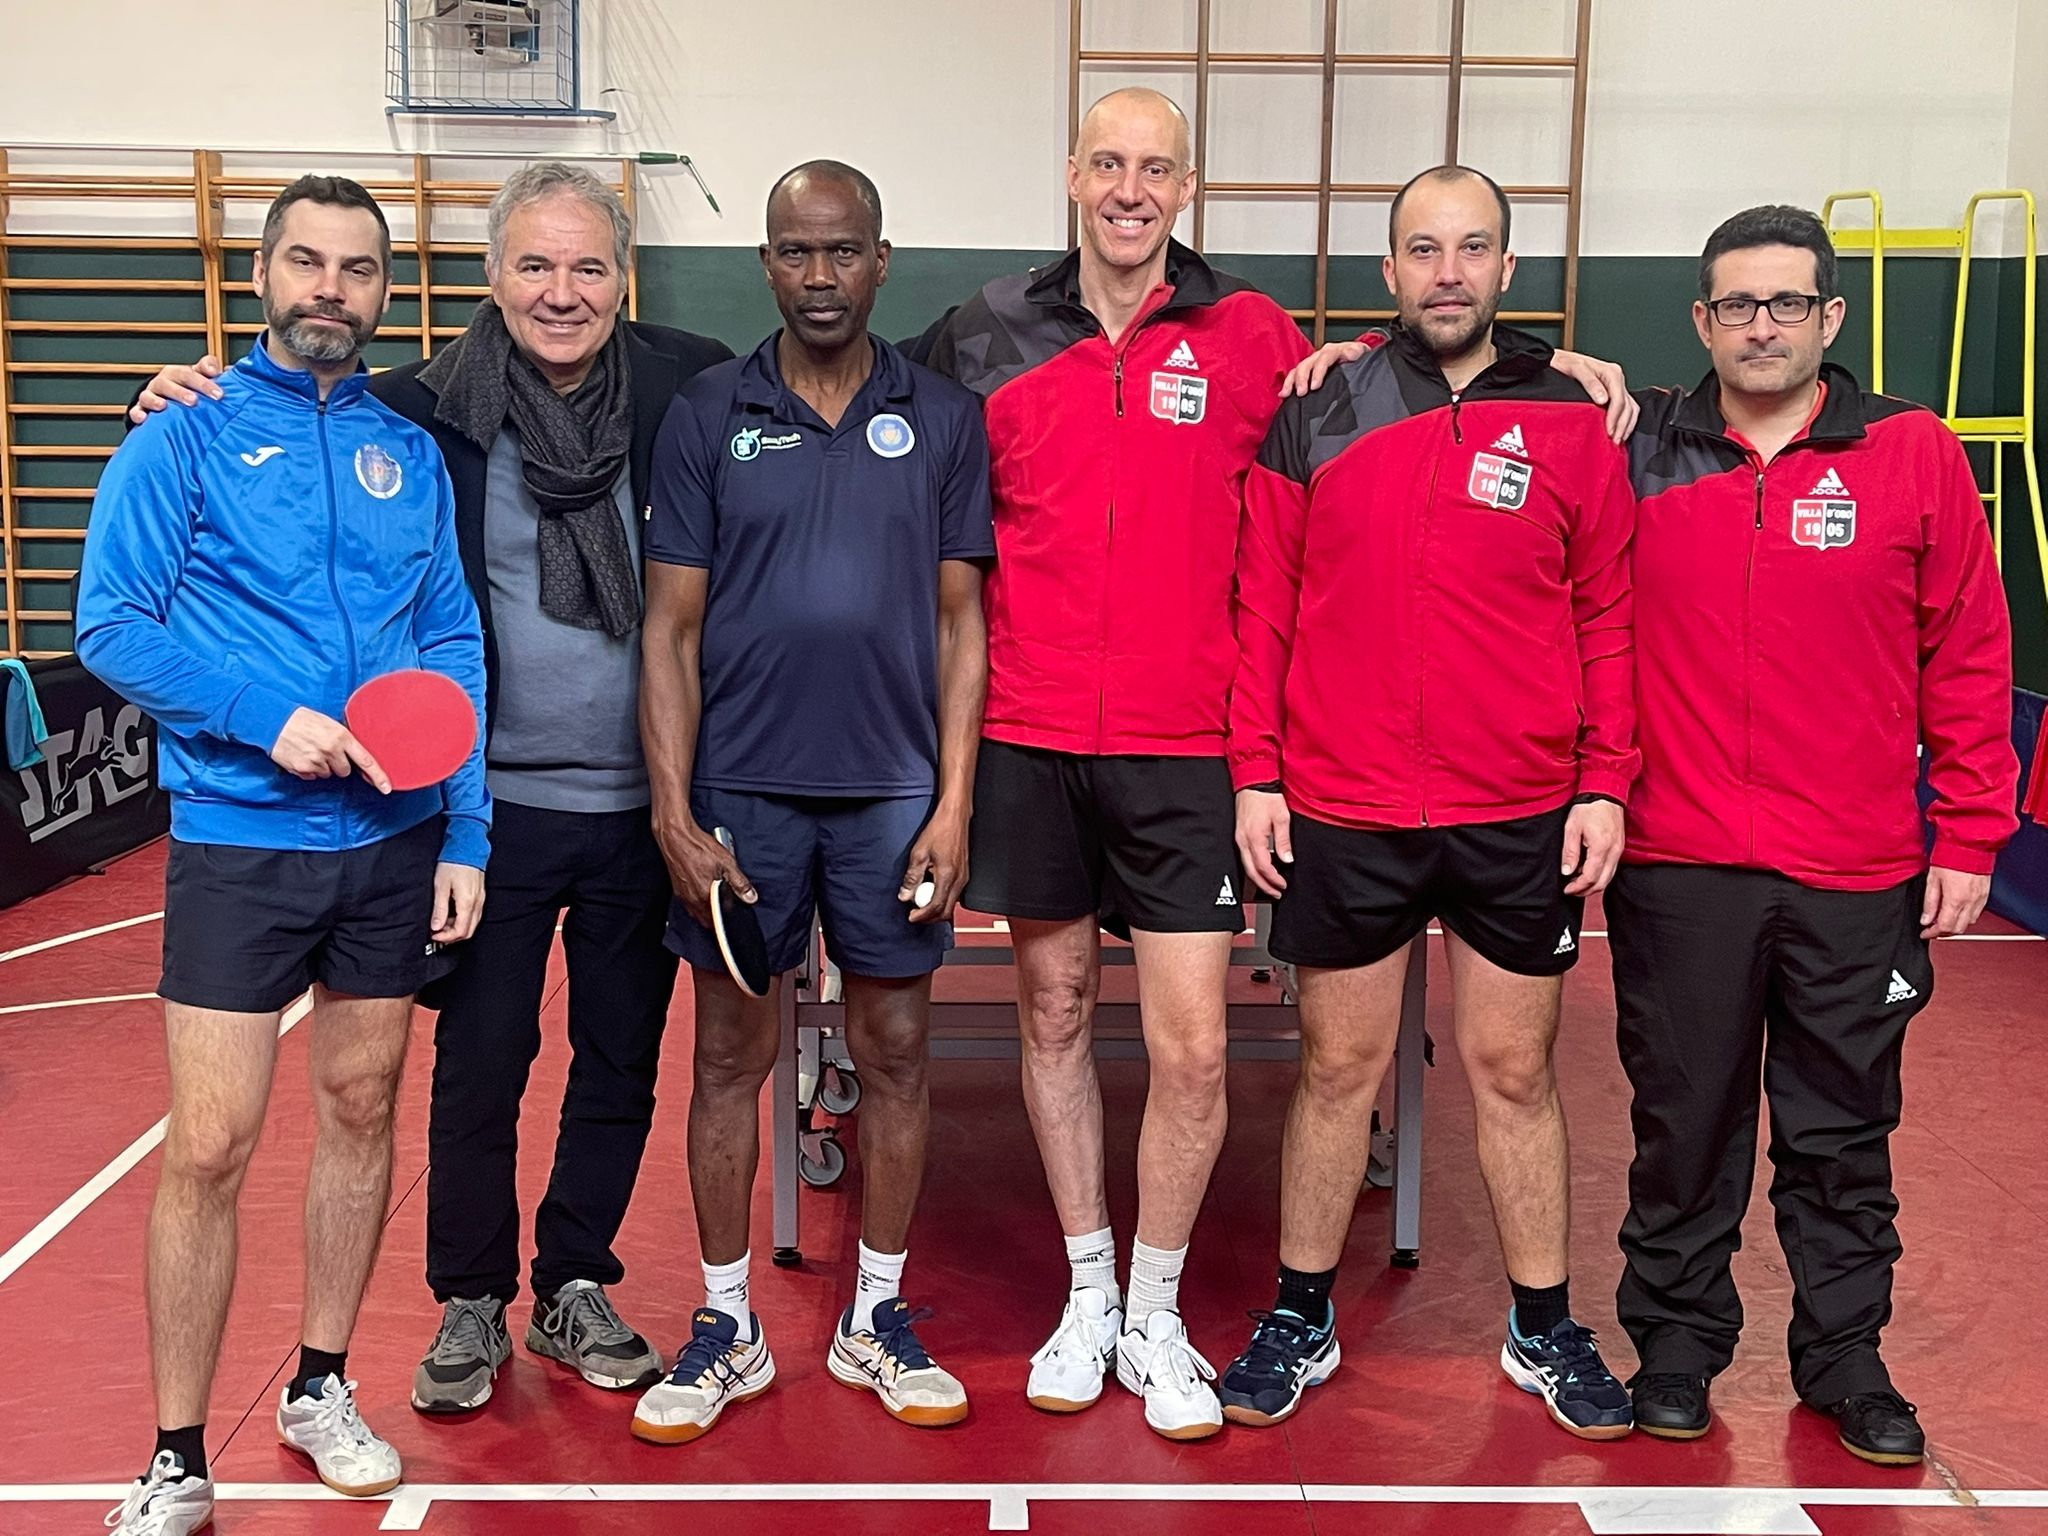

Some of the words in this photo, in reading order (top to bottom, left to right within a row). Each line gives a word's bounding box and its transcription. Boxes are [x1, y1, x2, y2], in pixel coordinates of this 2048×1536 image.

[1162, 358, 1200, 371] JOOLA
[1490, 440, 1529, 459] JOOLA
[1807, 487, 1851, 497] JOOLA
[1797, 508, 1823, 519] VILLA
[1884, 988, 1918, 1005] JOOLA
